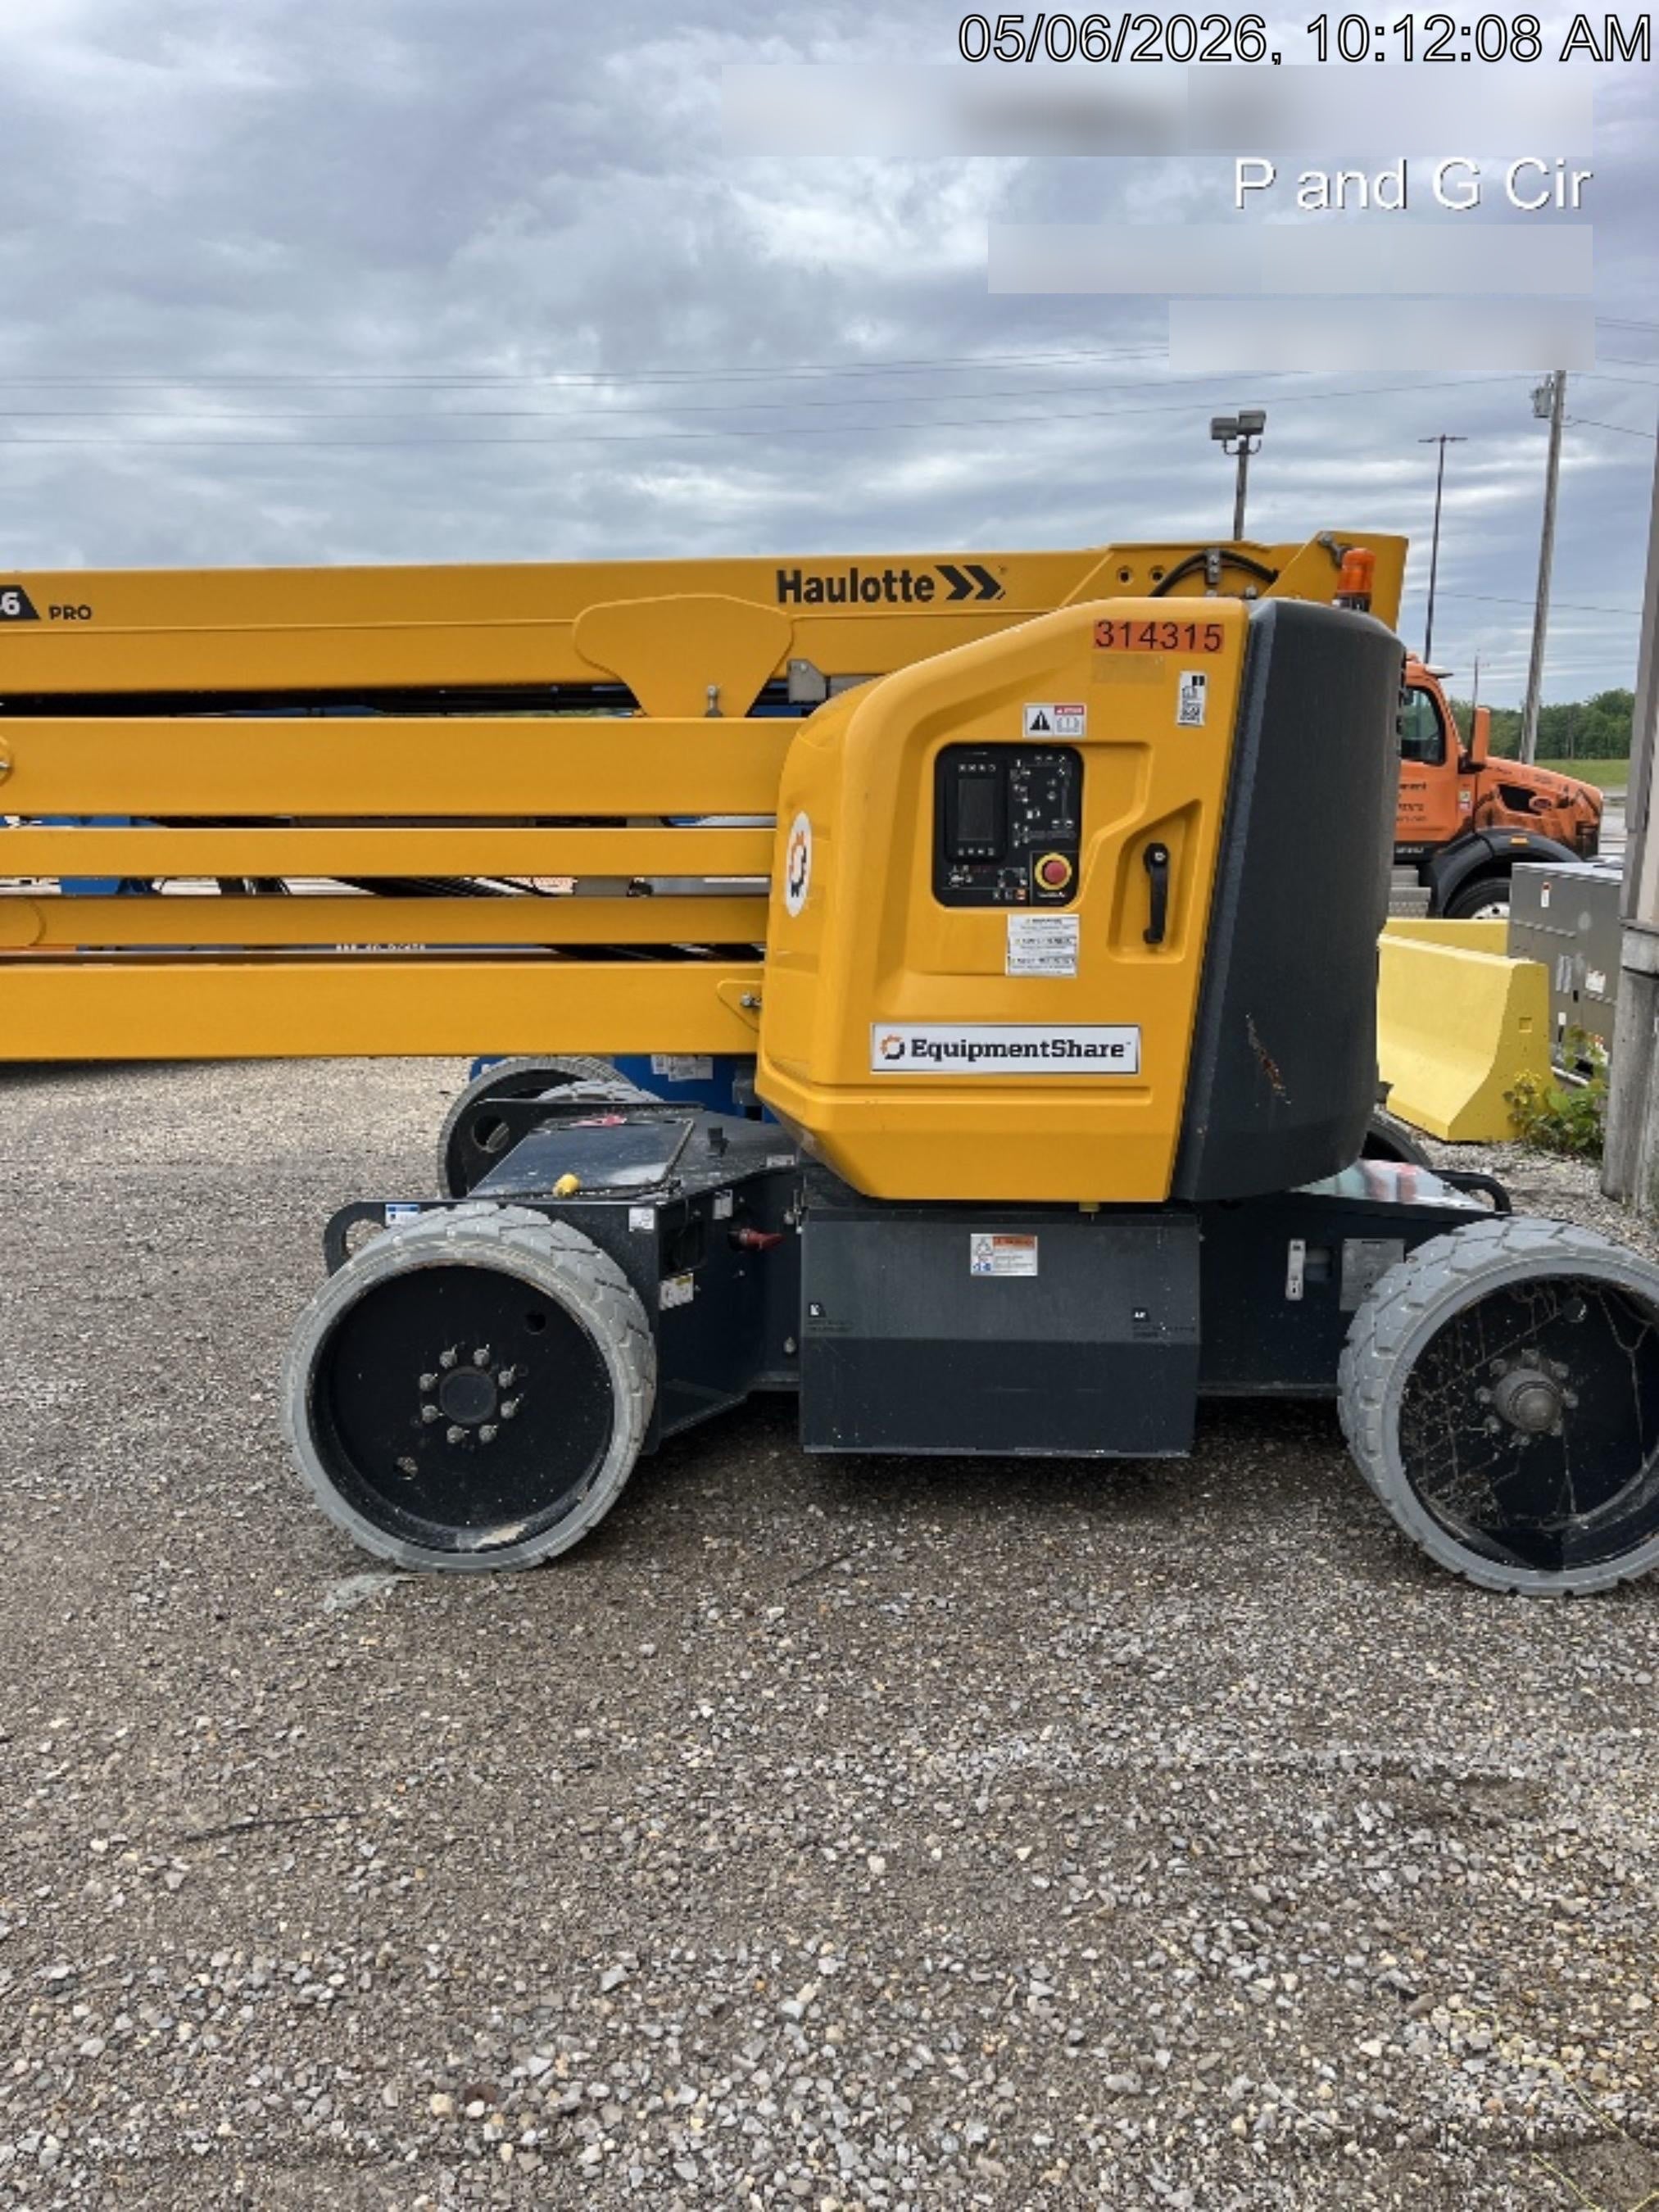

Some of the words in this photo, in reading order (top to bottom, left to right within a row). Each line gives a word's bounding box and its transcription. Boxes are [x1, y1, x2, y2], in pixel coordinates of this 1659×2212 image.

[777, 568, 935, 603] Haulotte
[49, 605, 92, 620] PRO
[1095, 620, 1222, 652] 314315
[911, 1039, 1125, 1062] EquipmentShare
